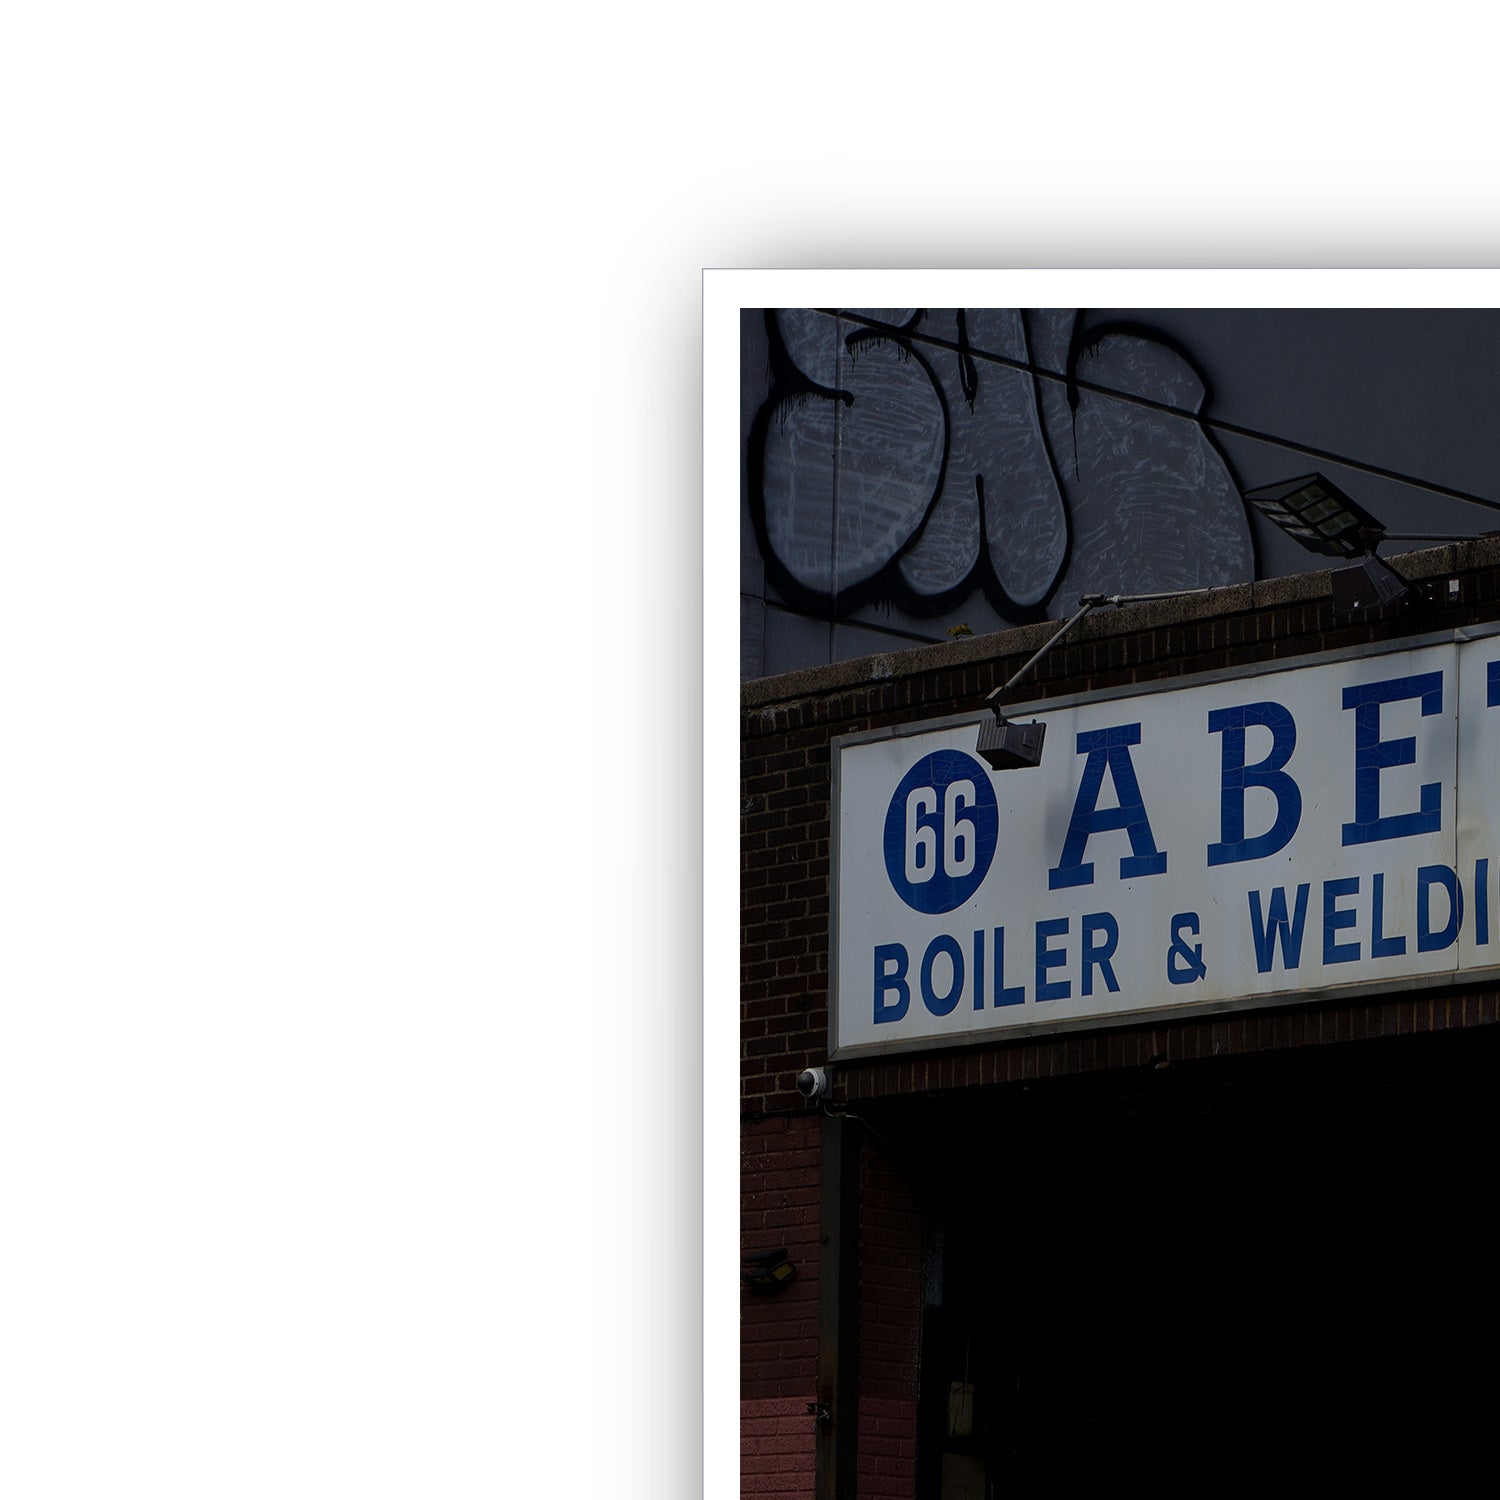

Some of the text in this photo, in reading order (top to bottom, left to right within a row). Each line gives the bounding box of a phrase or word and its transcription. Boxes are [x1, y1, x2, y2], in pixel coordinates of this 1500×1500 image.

[904, 778, 976, 886] 66
[873, 911, 1120, 1025] BOILER
[1167, 911, 1207, 984] &
